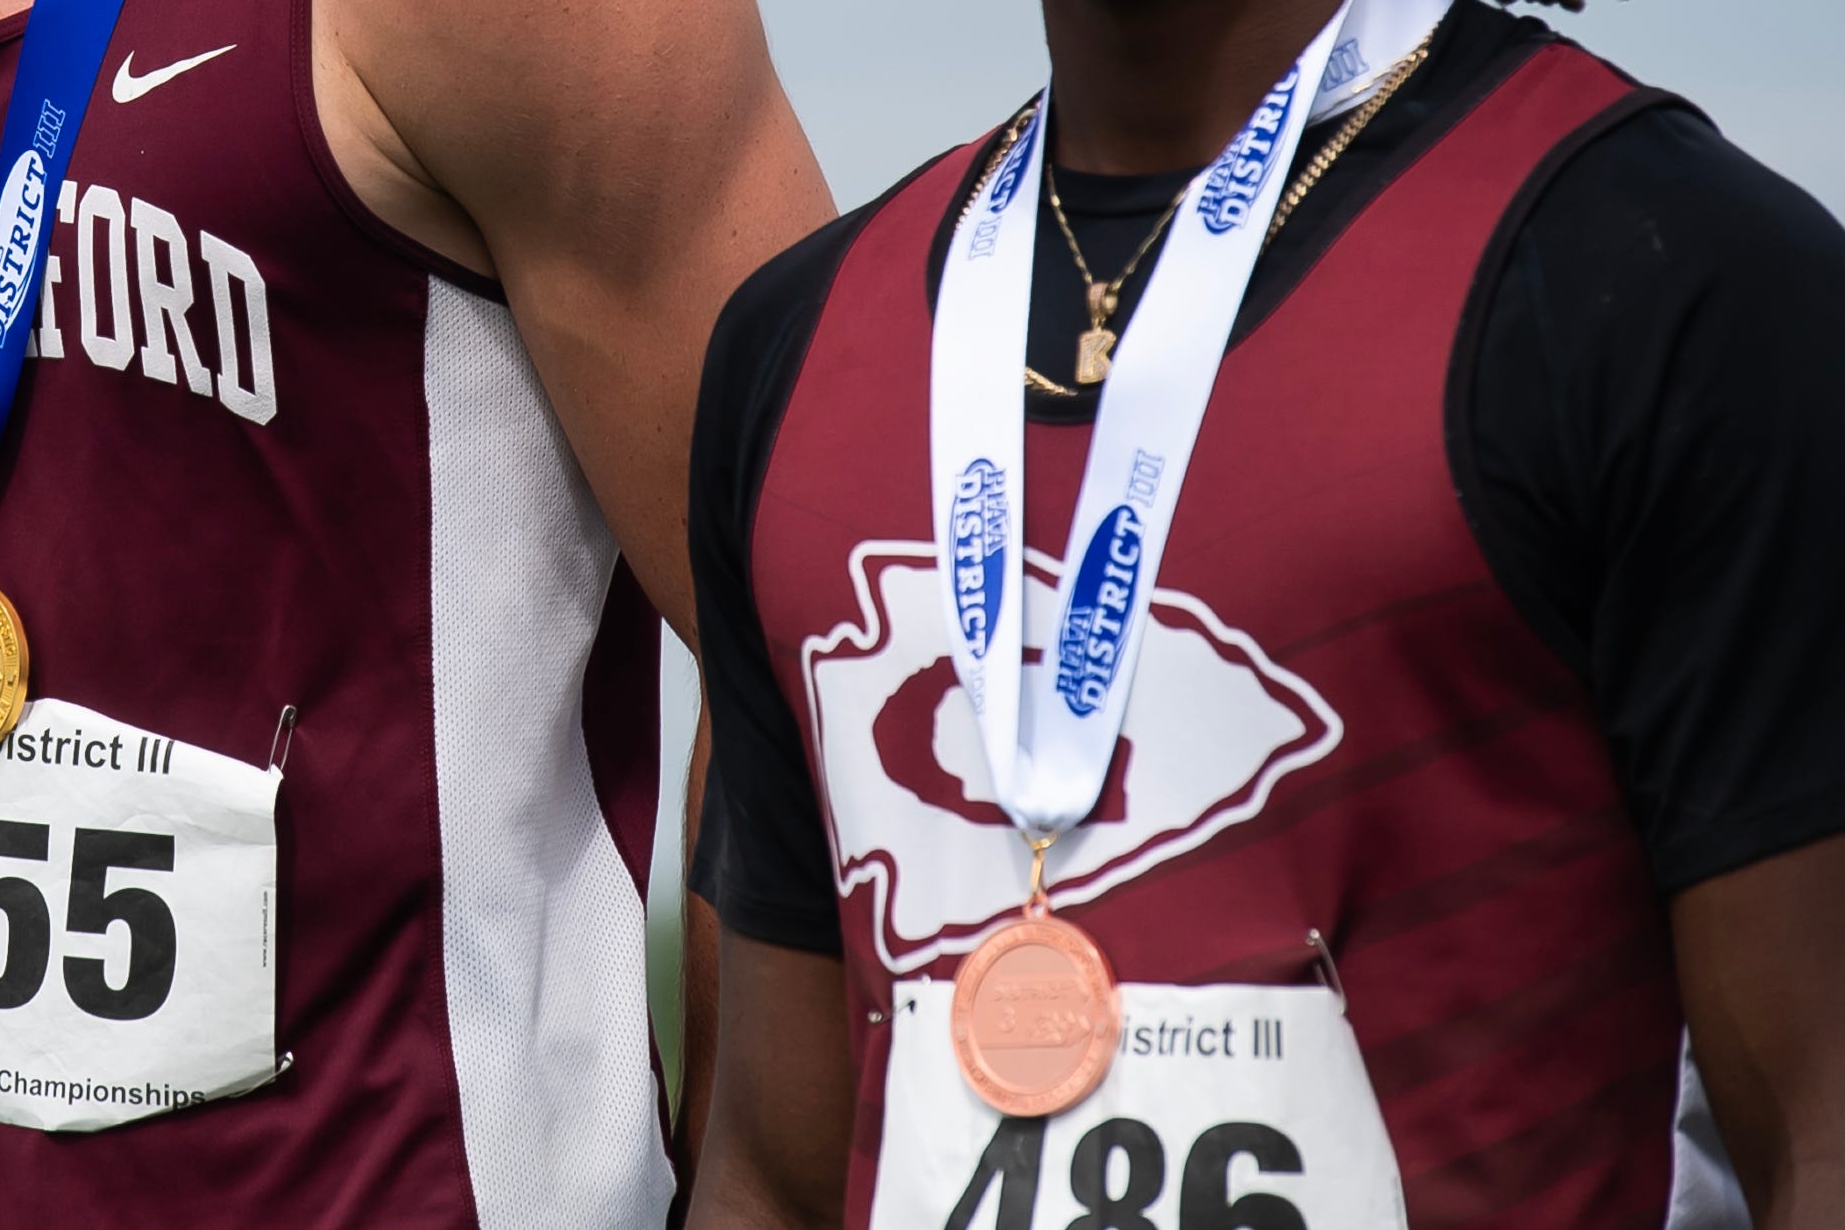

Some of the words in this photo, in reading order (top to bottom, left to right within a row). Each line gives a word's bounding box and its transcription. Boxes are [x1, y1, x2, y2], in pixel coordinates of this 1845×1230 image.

[32, 98, 66, 159] III
[1218, 68, 1300, 229] DISTRIC
[955, 473, 988, 659] DISTRICT
[1080, 507, 1147, 711] DISTRICT
[1121, 1016, 1236, 1060] istrict
